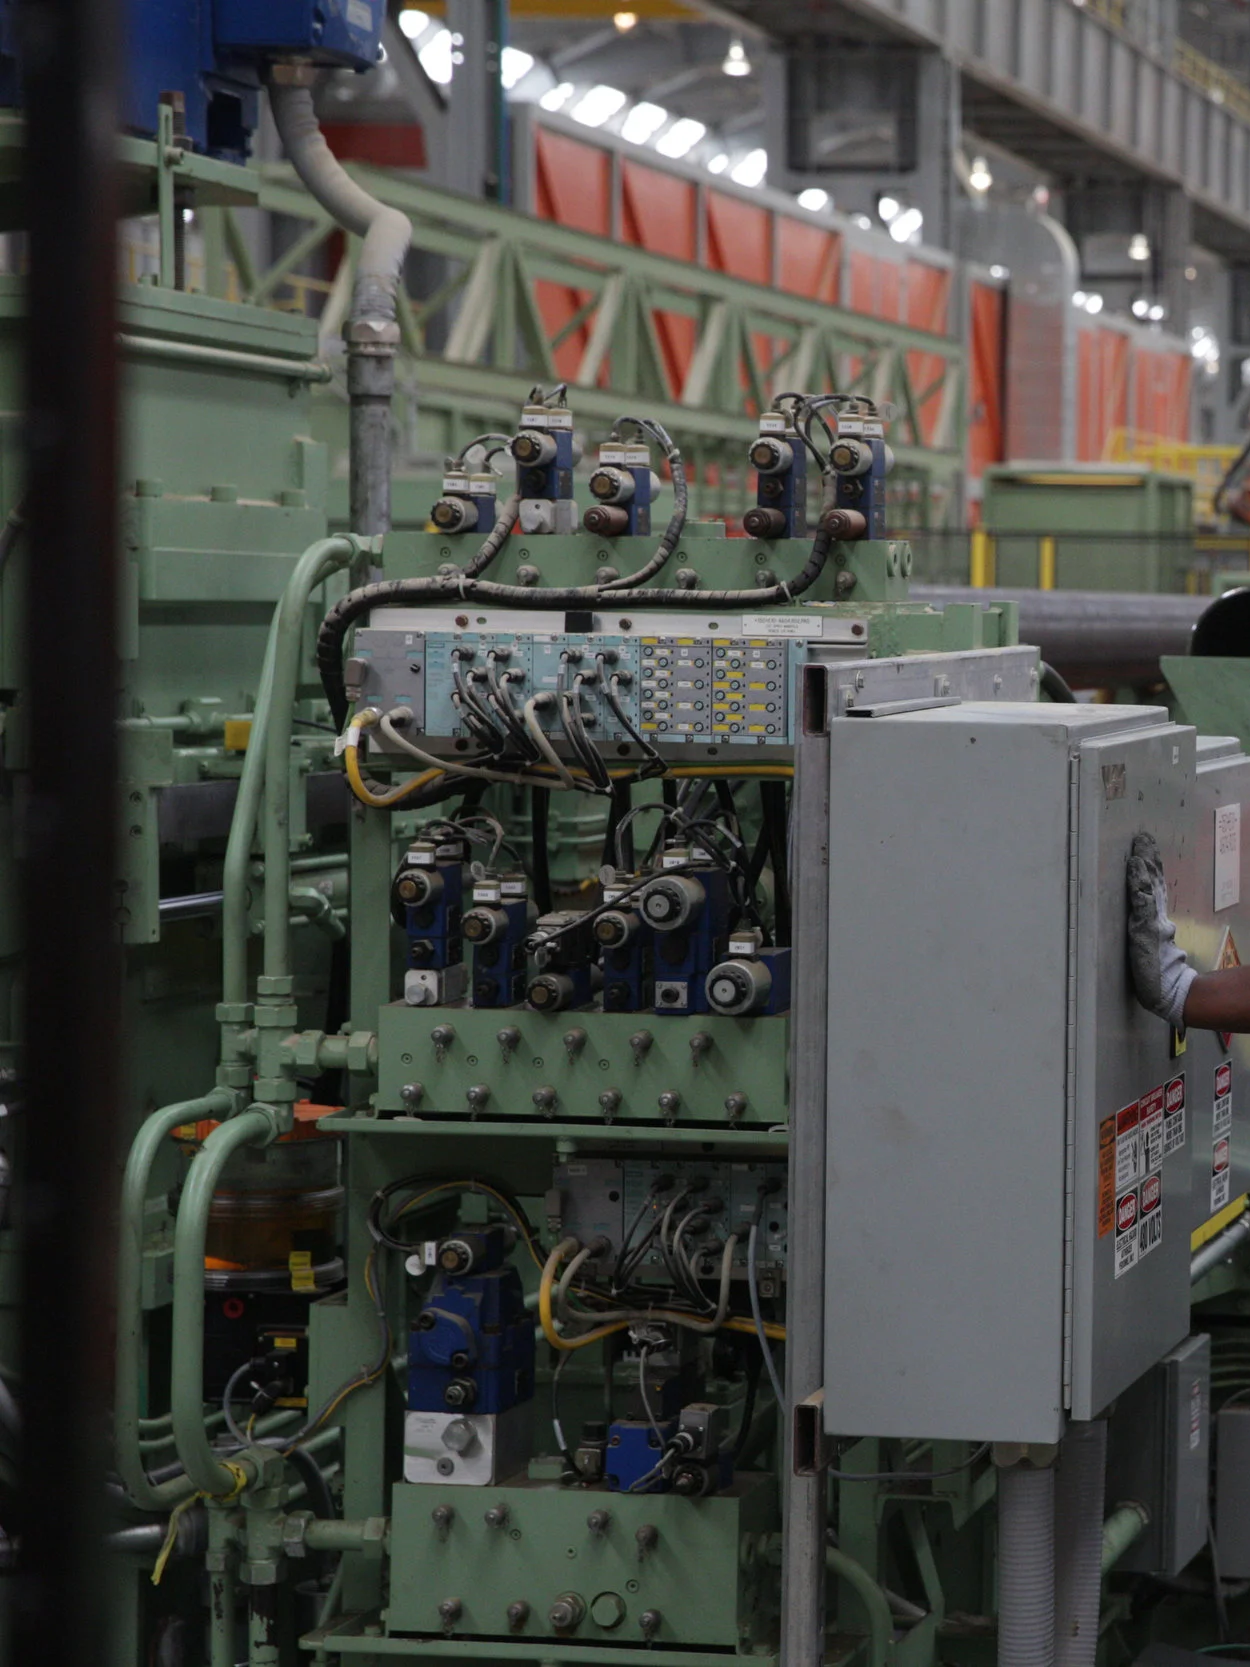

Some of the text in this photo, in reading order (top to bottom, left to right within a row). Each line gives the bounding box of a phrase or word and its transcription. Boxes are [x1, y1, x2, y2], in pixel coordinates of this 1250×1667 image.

[1166, 1084, 1182, 1108] DANGER
[1143, 1182, 1159, 1208] DANGER
[1118, 1198, 1135, 1225] DANGER
[1148, 1210, 1161, 1247] VOLTS
